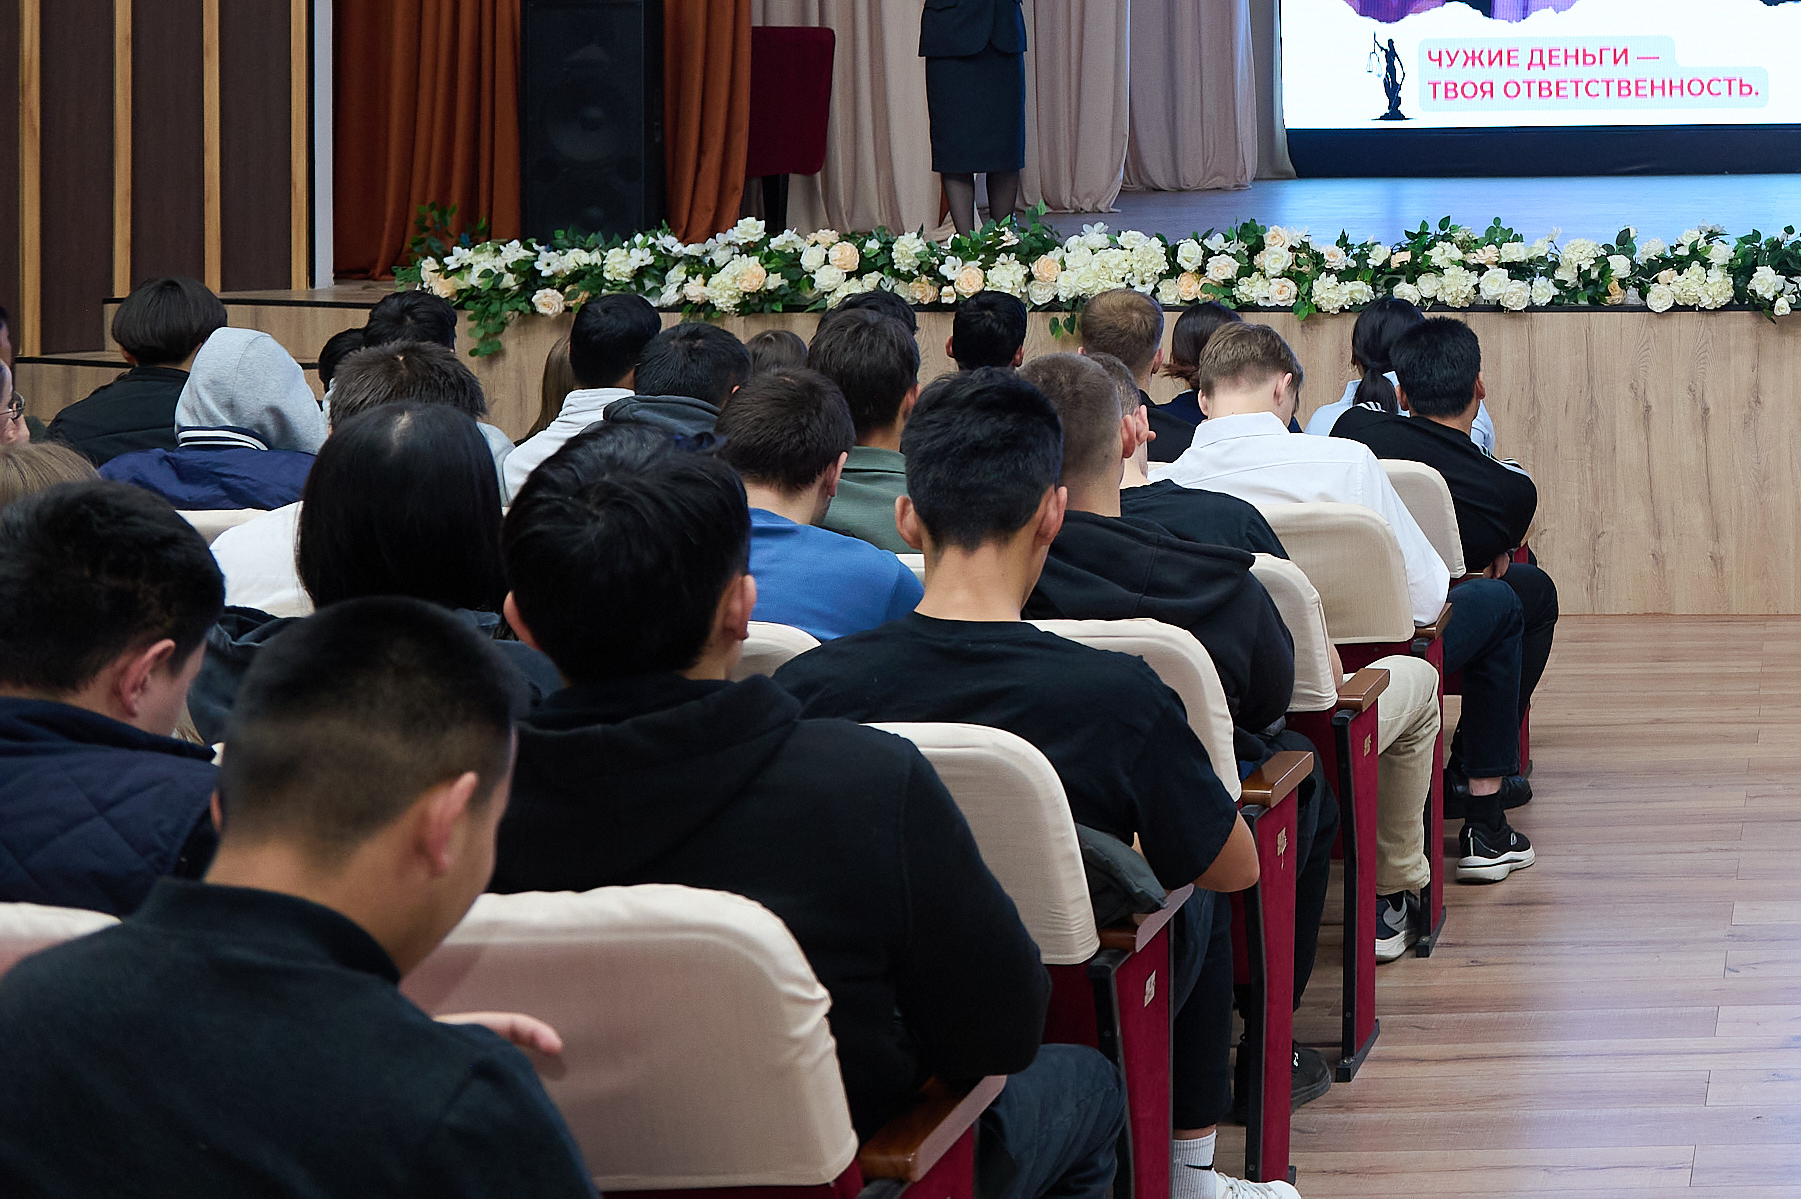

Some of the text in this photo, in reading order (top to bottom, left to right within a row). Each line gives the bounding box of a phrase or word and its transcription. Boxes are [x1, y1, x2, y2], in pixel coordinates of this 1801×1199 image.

[1427, 48, 1520, 69] ЧУЖИЕ
[1527, 47, 1629, 71] ДЕНЬГИ
[1427, 77, 1759, 101] ТВОЯ ОТВЕТСТВЕННОСТЬ.
